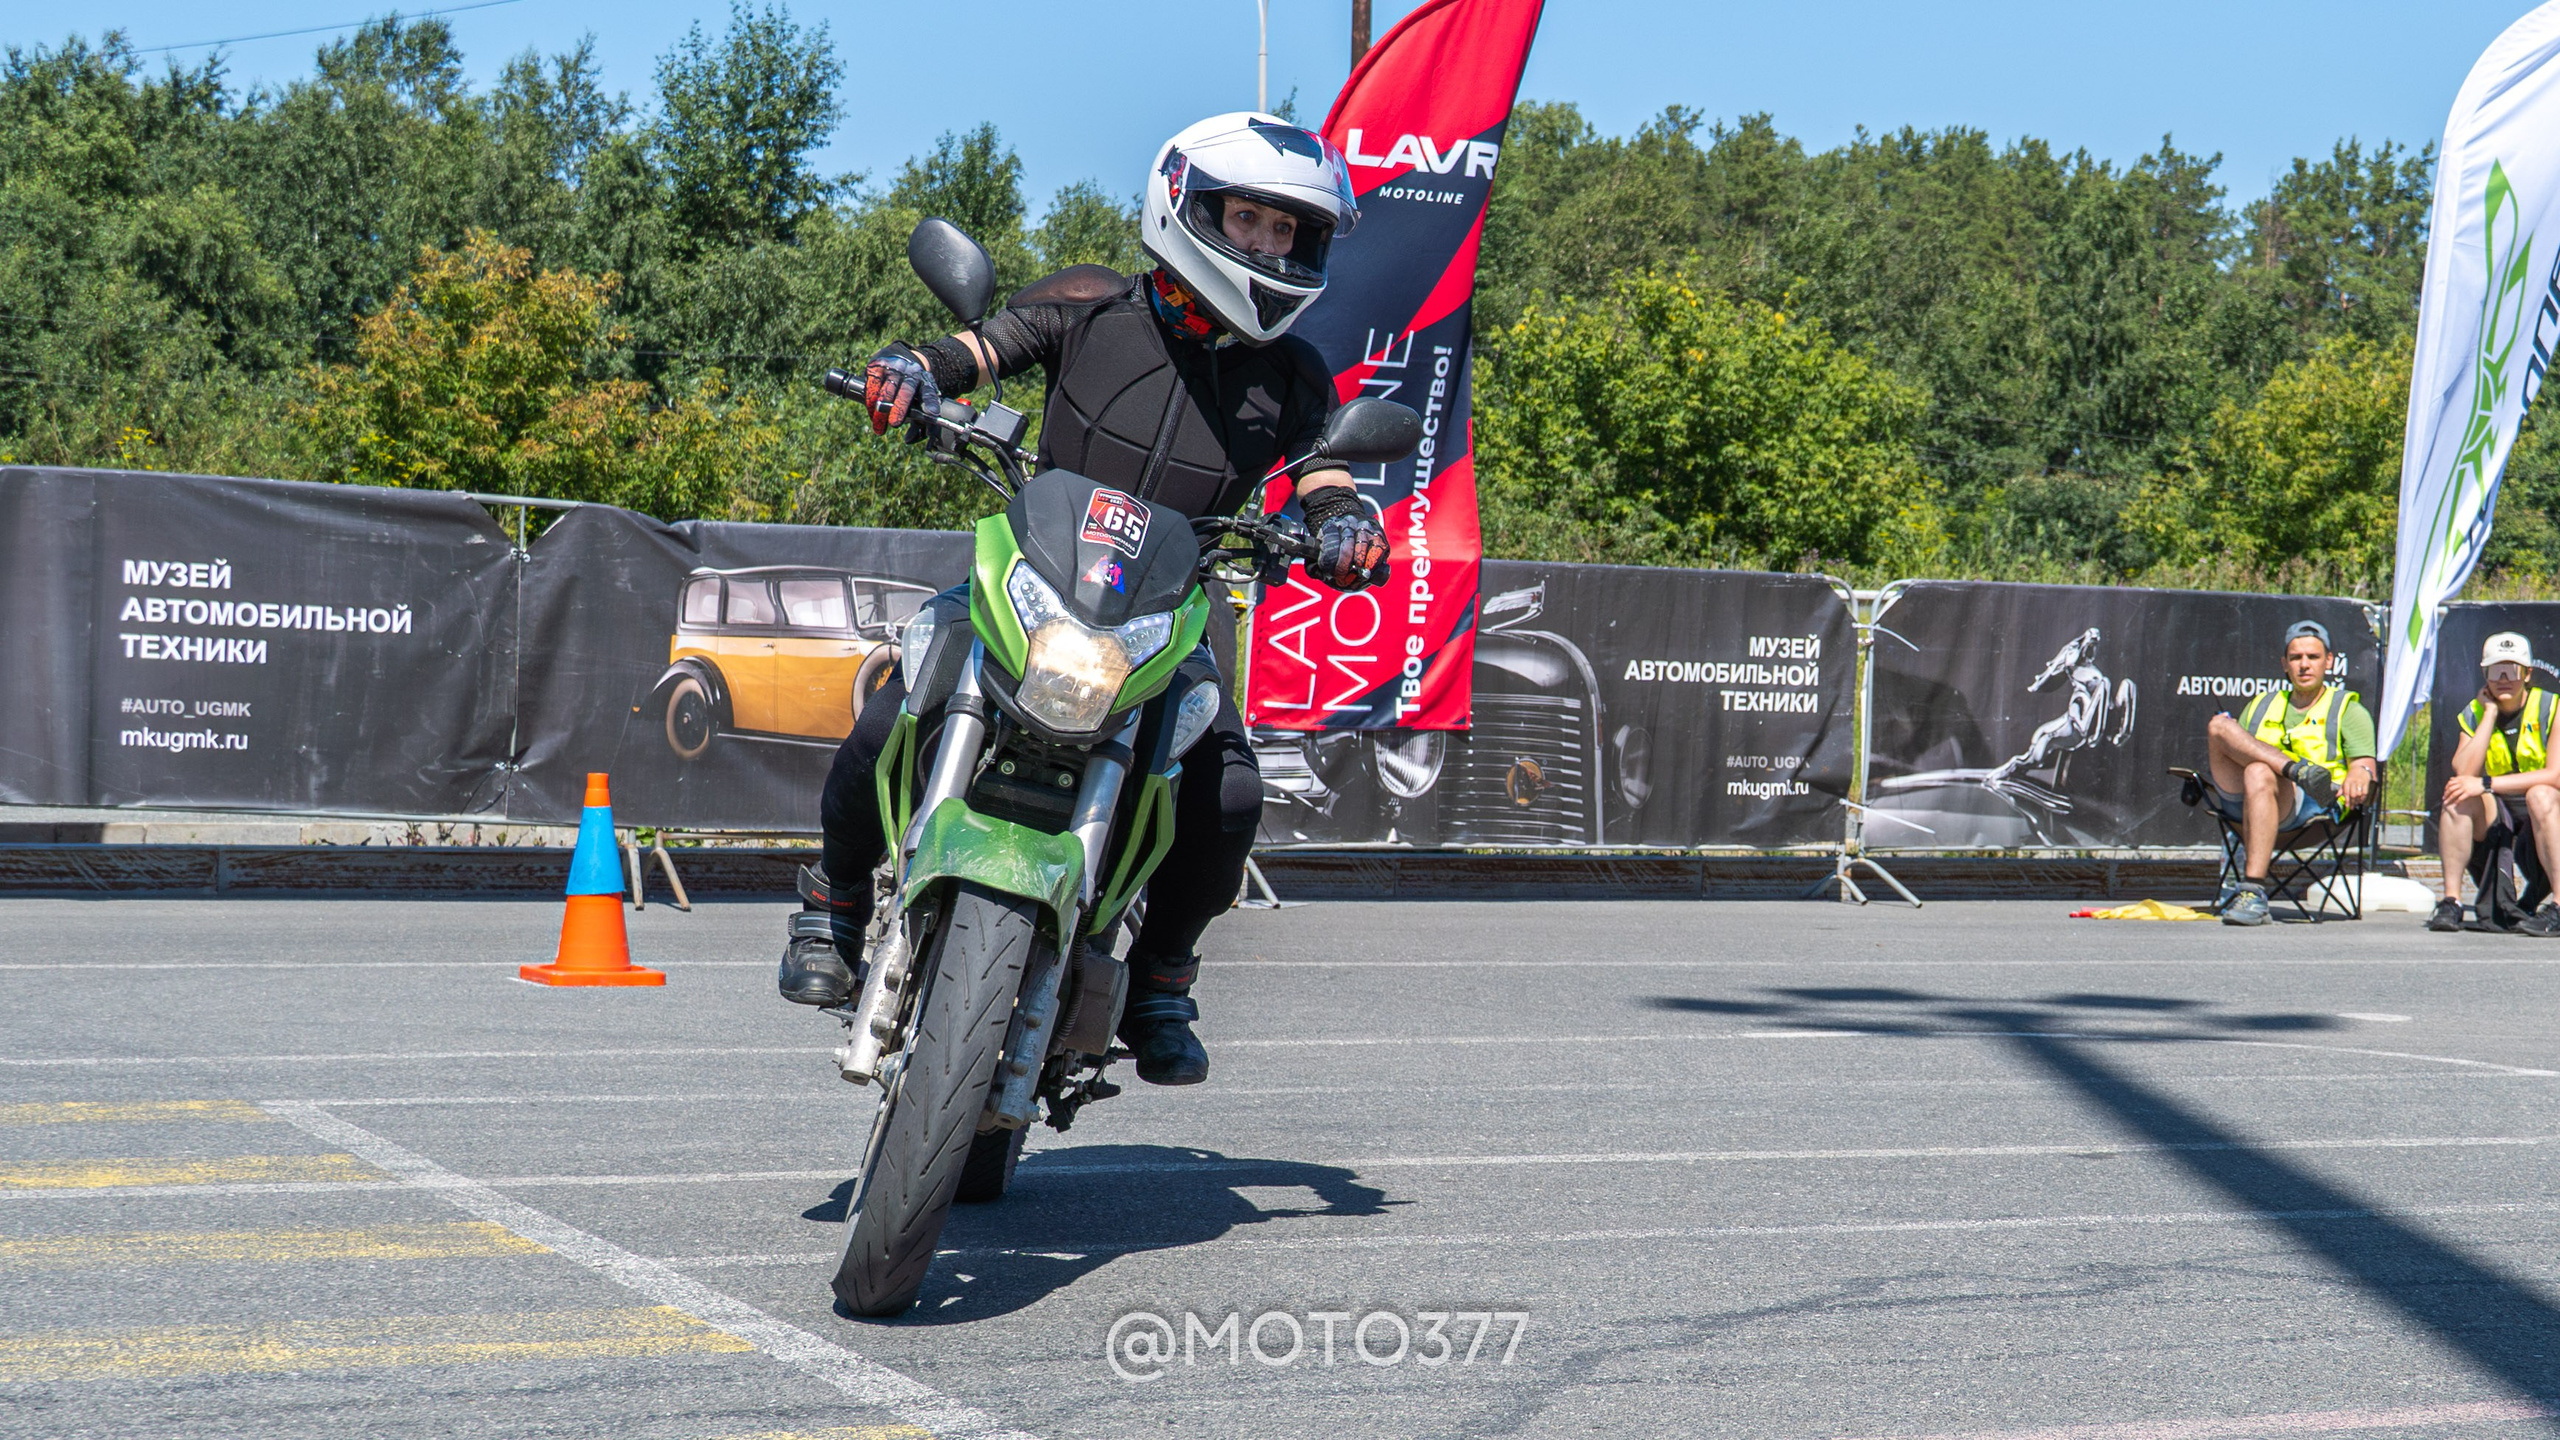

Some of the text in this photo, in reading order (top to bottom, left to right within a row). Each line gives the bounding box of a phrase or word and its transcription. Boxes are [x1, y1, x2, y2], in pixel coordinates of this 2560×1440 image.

[1346, 129, 1499, 180] LAVR
[1379, 186, 1464, 205] MOTOLINE
[1104, 506, 1144, 541] 65
[1396, 346, 1452, 719] Твое преимущество!
[123, 559, 231, 589] МУЗЕЙ
[120, 598, 412, 634] АВТОМОБИЛЬНОЙ
[1263, 557, 1322, 709] LAV
[1749, 634, 1821, 659] МУЗЕЙ
[120, 635, 268, 664] ТЕХНИКИ
[1625, 660, 1819, 686] АВТОМОБИЛЬНОЙ
[121, 698, 251, 719] #AUTO_UGMK
[1720, 690, 1818, 713] ТЕХНИКИ
[121, 726, 248, 753] mkugmk.ru
[1727, 779, 1810, 800] mkugmk.ru
